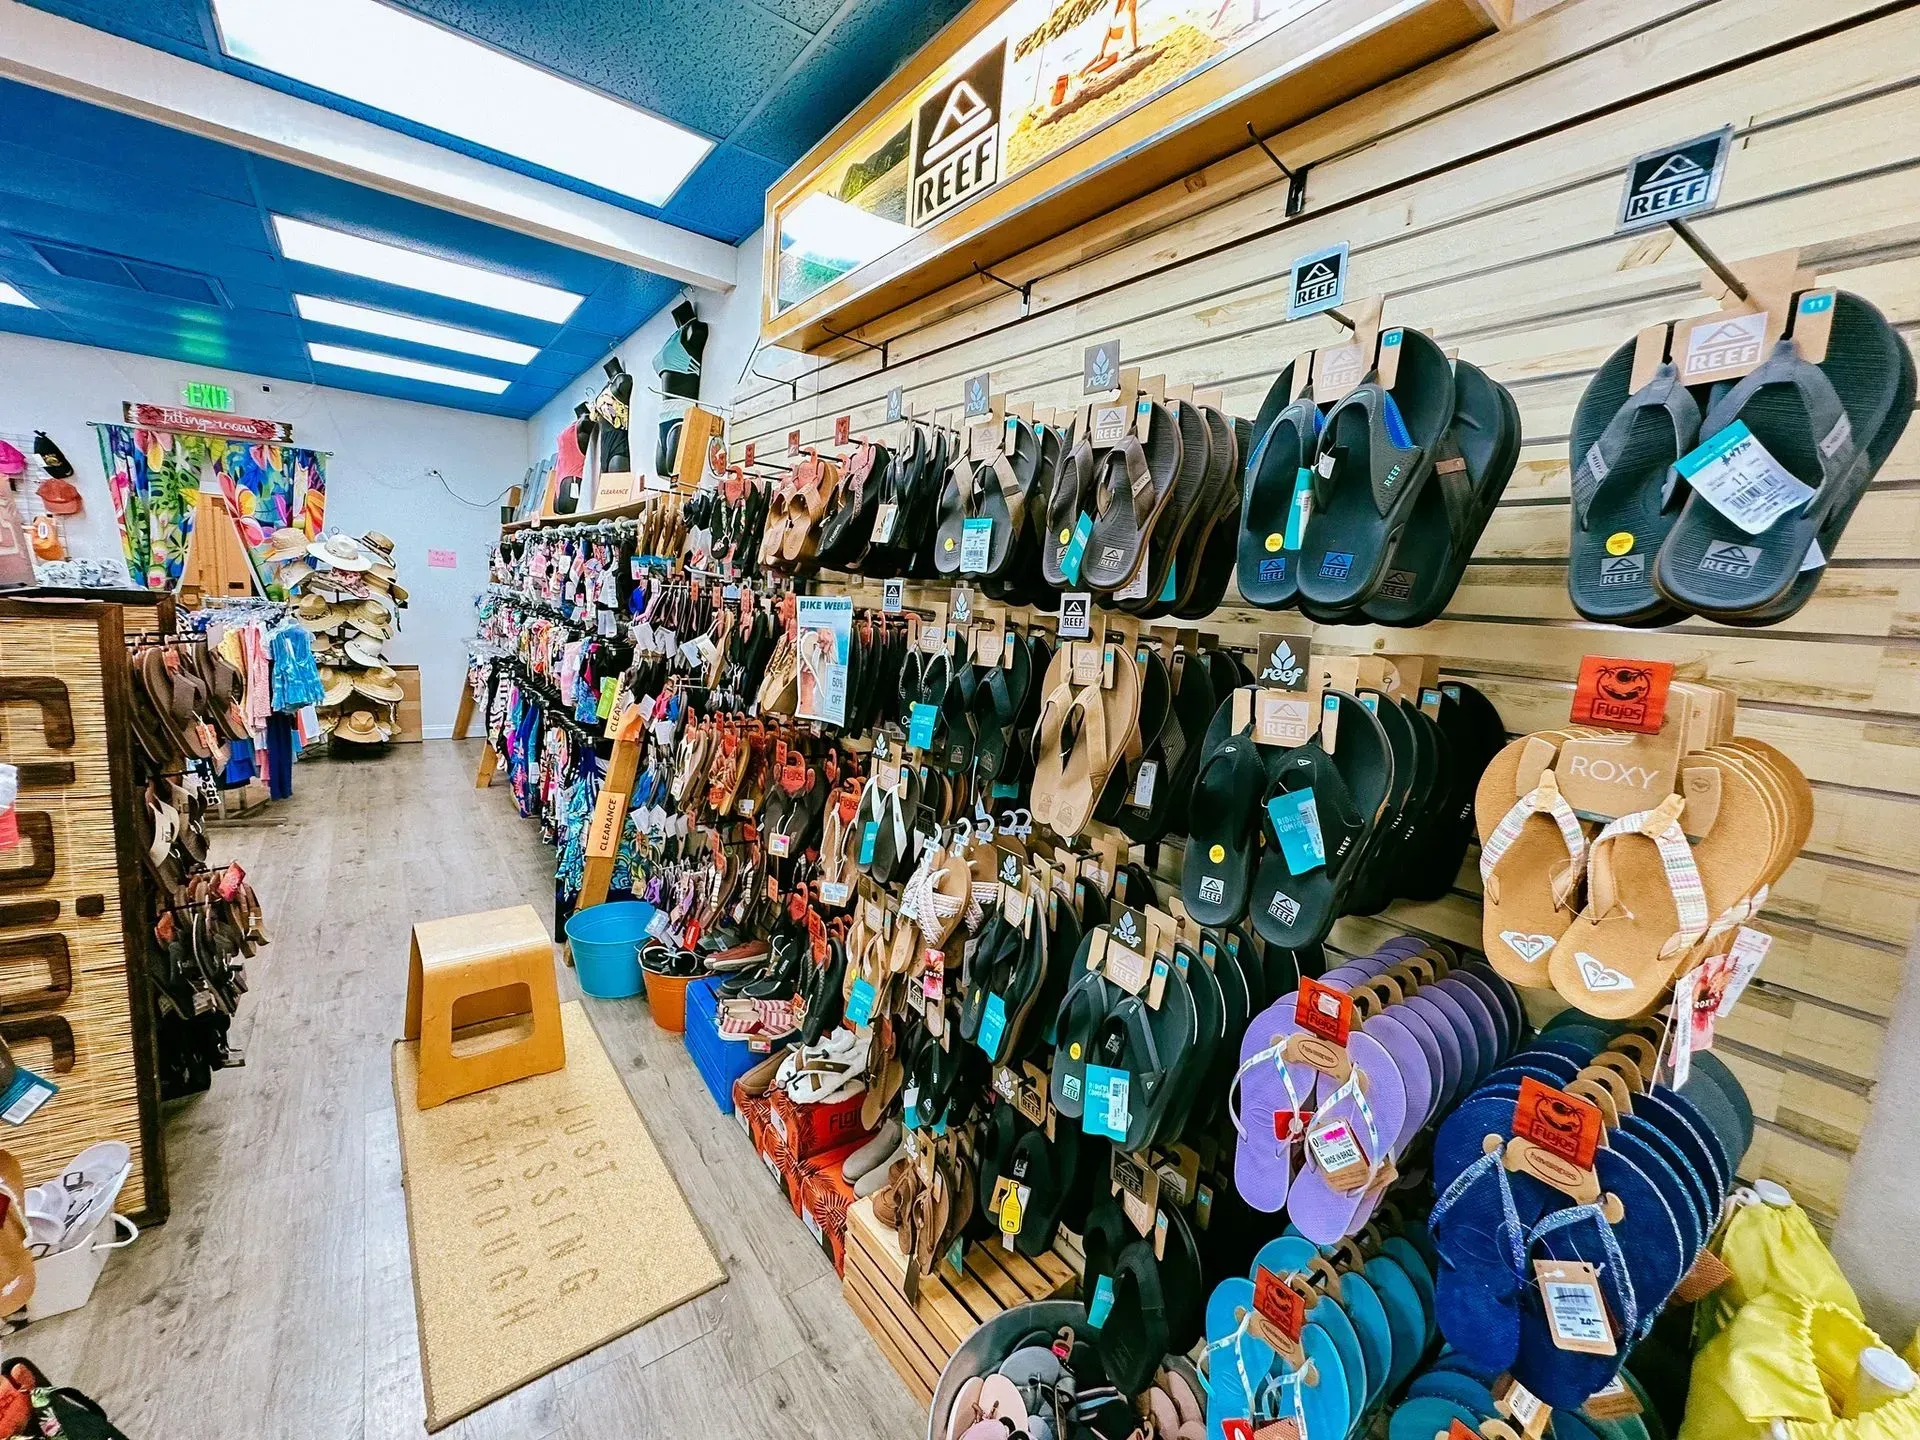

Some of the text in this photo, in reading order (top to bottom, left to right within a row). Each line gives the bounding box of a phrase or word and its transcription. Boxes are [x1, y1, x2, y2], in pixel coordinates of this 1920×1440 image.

[917, 134, 994, 221] REEF
[1631, 180, 1705, 218] REEF
[1296, 281, 1337, 306] REEF
[1808, 300, 1825, 309] 11
[1690, 345, 1760, 372] REEF
[1086, 367, 1115, 389] reef
[1322, 368, 1362, 387] REEF
[189, 383, 227, 409] EXIT
[967, 397, 987, 414] reef
[1096, 426, 1124, 441] REEF
[1383, 464, 1402, 487] REEF
[1732, 472, 1749, 486] 11
[1321, 566, 1348, 580] REEF
[1701, 558, 1750, 575] REEF
[1260, 572, 1284, 582] REEF
[1602, 572, 1643, 585] REEF
[800, 600, 822, 611] BIKE
[824, 601, 843, 610] WEEK
[886, 597, 900, 606] REEF
[951, 608, 970, 621] reef
[1064, 617, 1084, 628] REEF
[1260, 664, 1304, 685] reef
[832, 695, 841, 704] OFF
[1594, 702, 1643, 724] Flojos
[1264, 722, 1307, 738] REEF
[1570, 755, 1660, 791] ROXY
[600, 798, 617, 851] CLEARANCE
[1336, 835, 1351, 857] REEF
[999, 869, 1020, 886] reef
[1200, 890, 1224, 903] REEF
[1269, 903, 1295, 926] REEF
[1111, 928, 1141, 948] reef
[1111, 965, 1141, 989] REEF
[908, 991, 923, 1011] REEF
[1694, 999, 1715, 1009] ROXY
[1310, 1012, 1339, 1034] Flojos
[1062, 1085, 1080, 1101] REEF
[1021, 1099, 1041, 1117] REEF
[556, 1103, 617, 1178] JUST
[1530, 1126, 1579, 1155] Flojos
[1324, 1155, 1338, 1165] MADE
[1340, 1148, 1357, 1159] BRAZIL
[1115, 1173, 1143, 1196] REEF
[507, 1115, 599, 1296] PASSING
[455, 1131, 538, 1331] THROUGH
